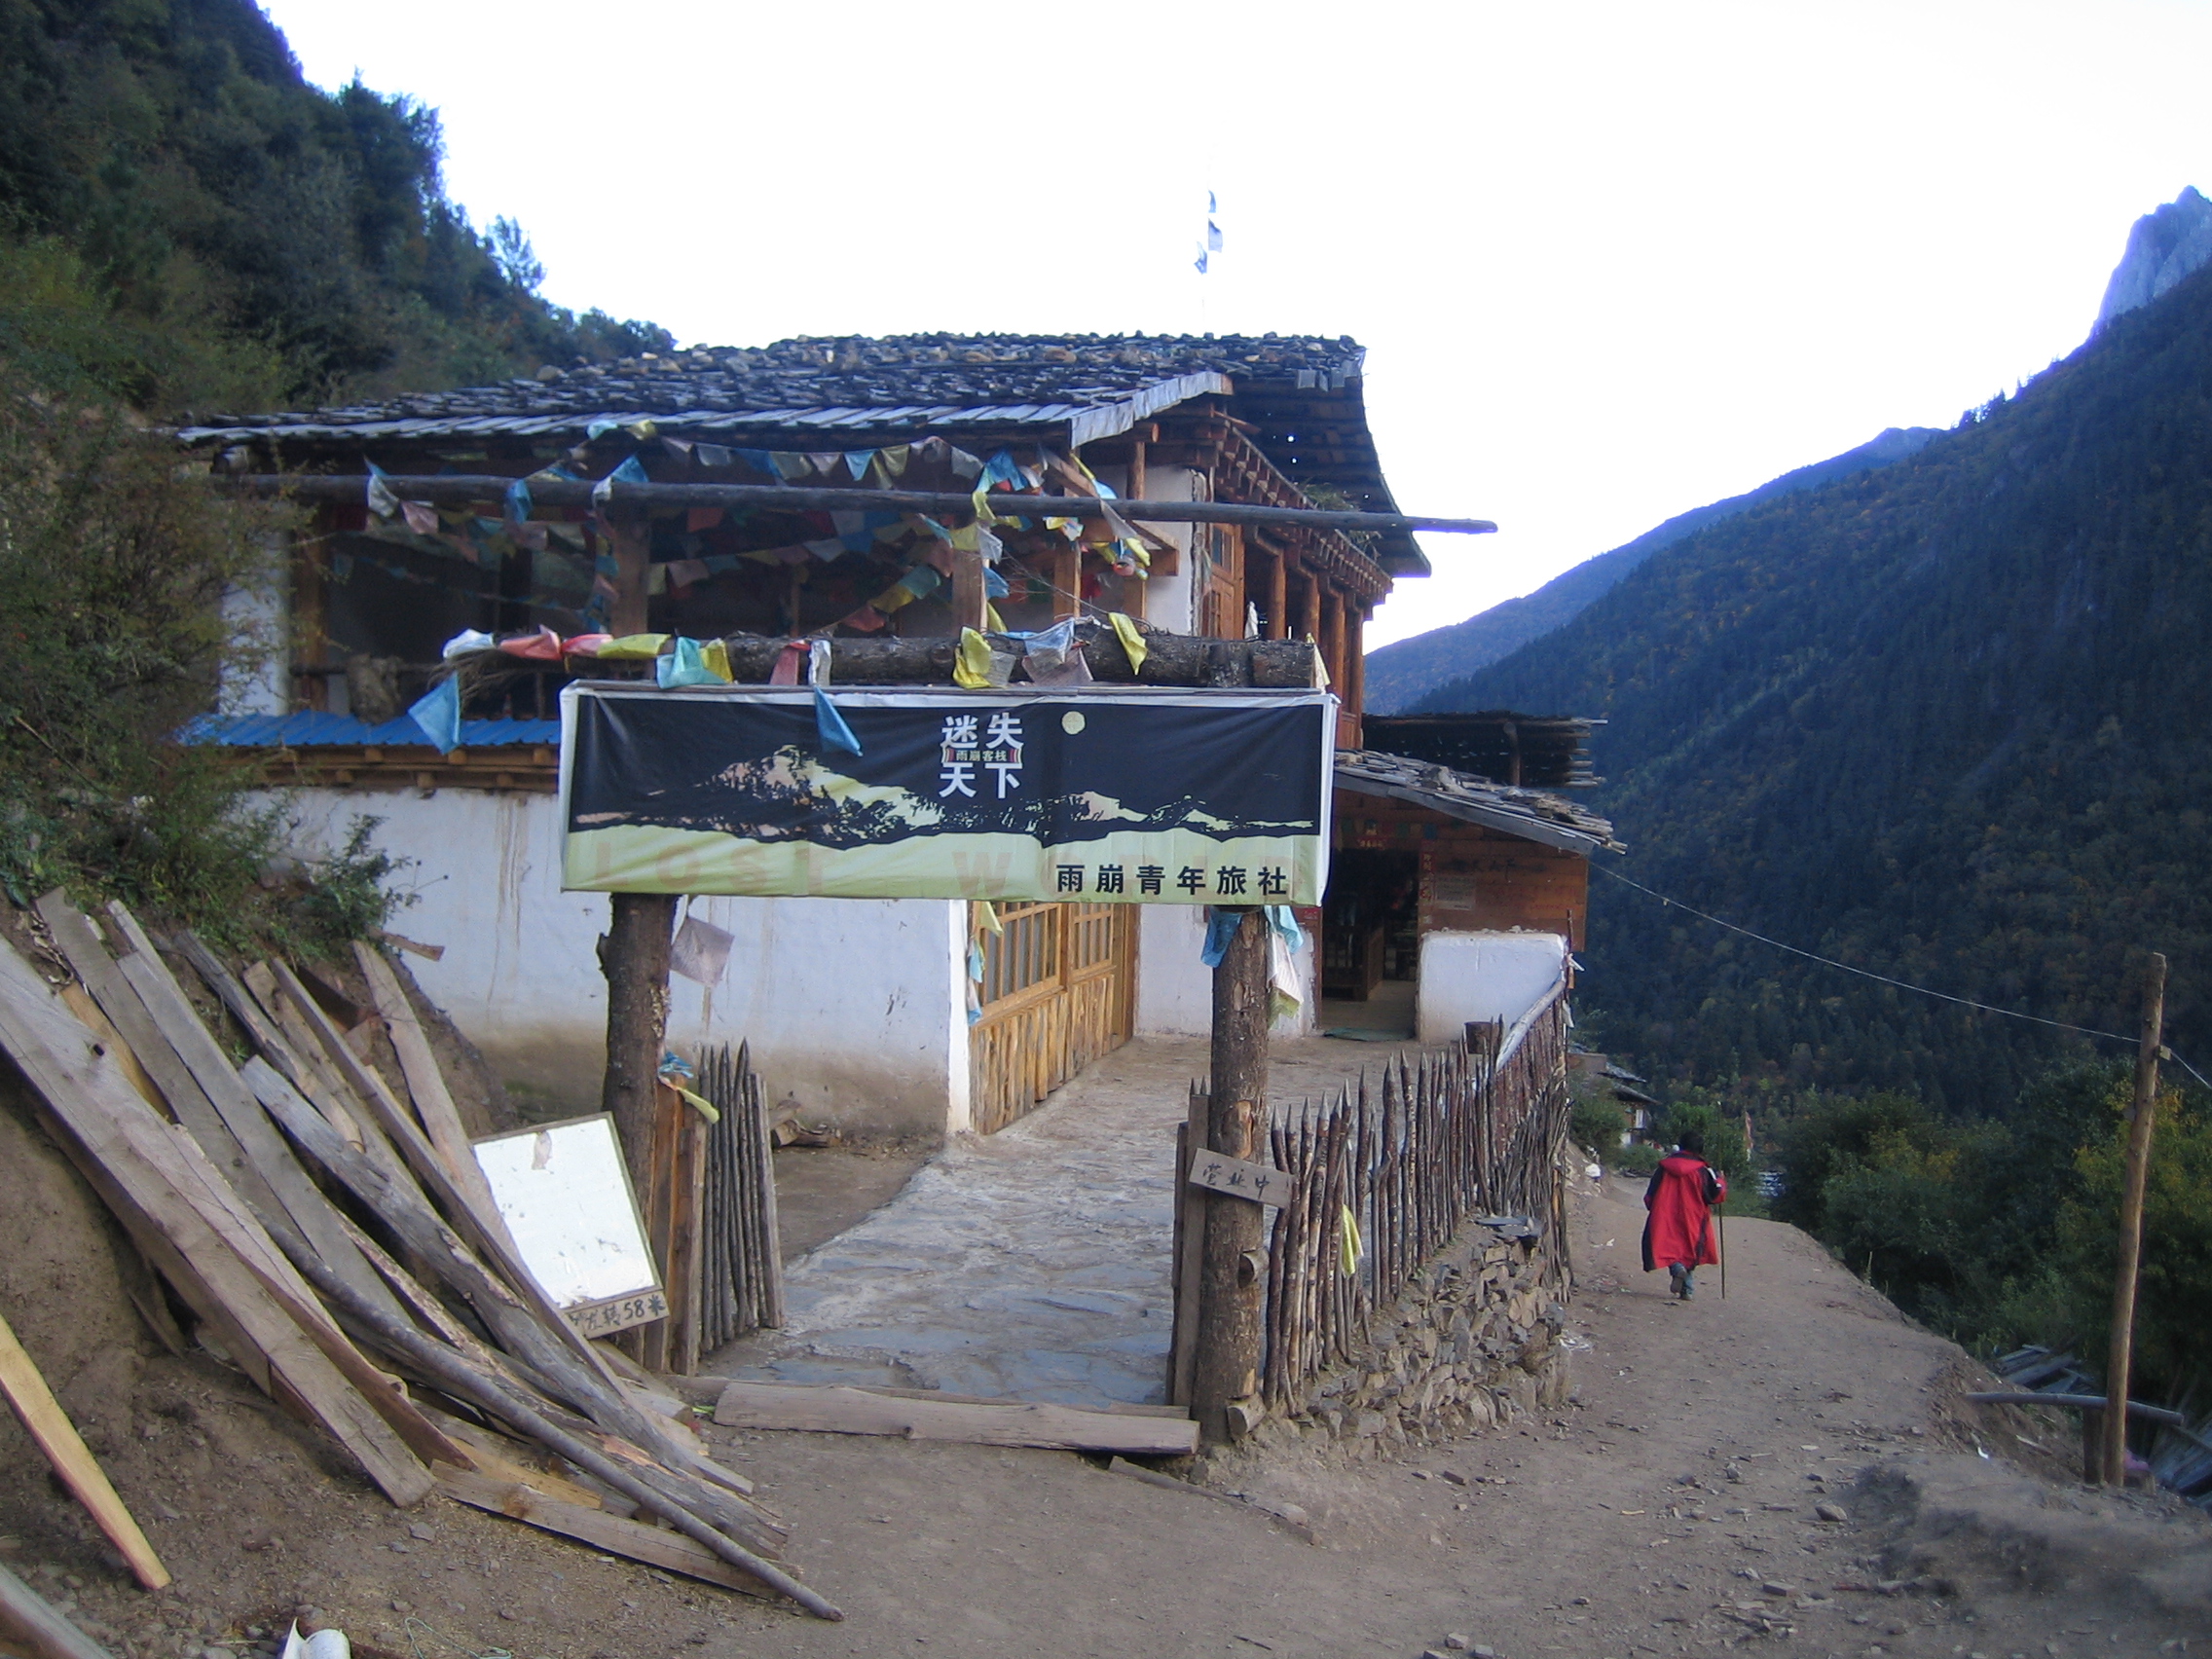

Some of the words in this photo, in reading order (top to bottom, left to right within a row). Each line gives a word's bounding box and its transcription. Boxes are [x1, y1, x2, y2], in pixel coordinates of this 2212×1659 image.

[940, 712, 1024, 749] 迷失
[939, 762, 1023, 798] 天下
[1056, 864, 1287, 896] 雨崩青年旅社
